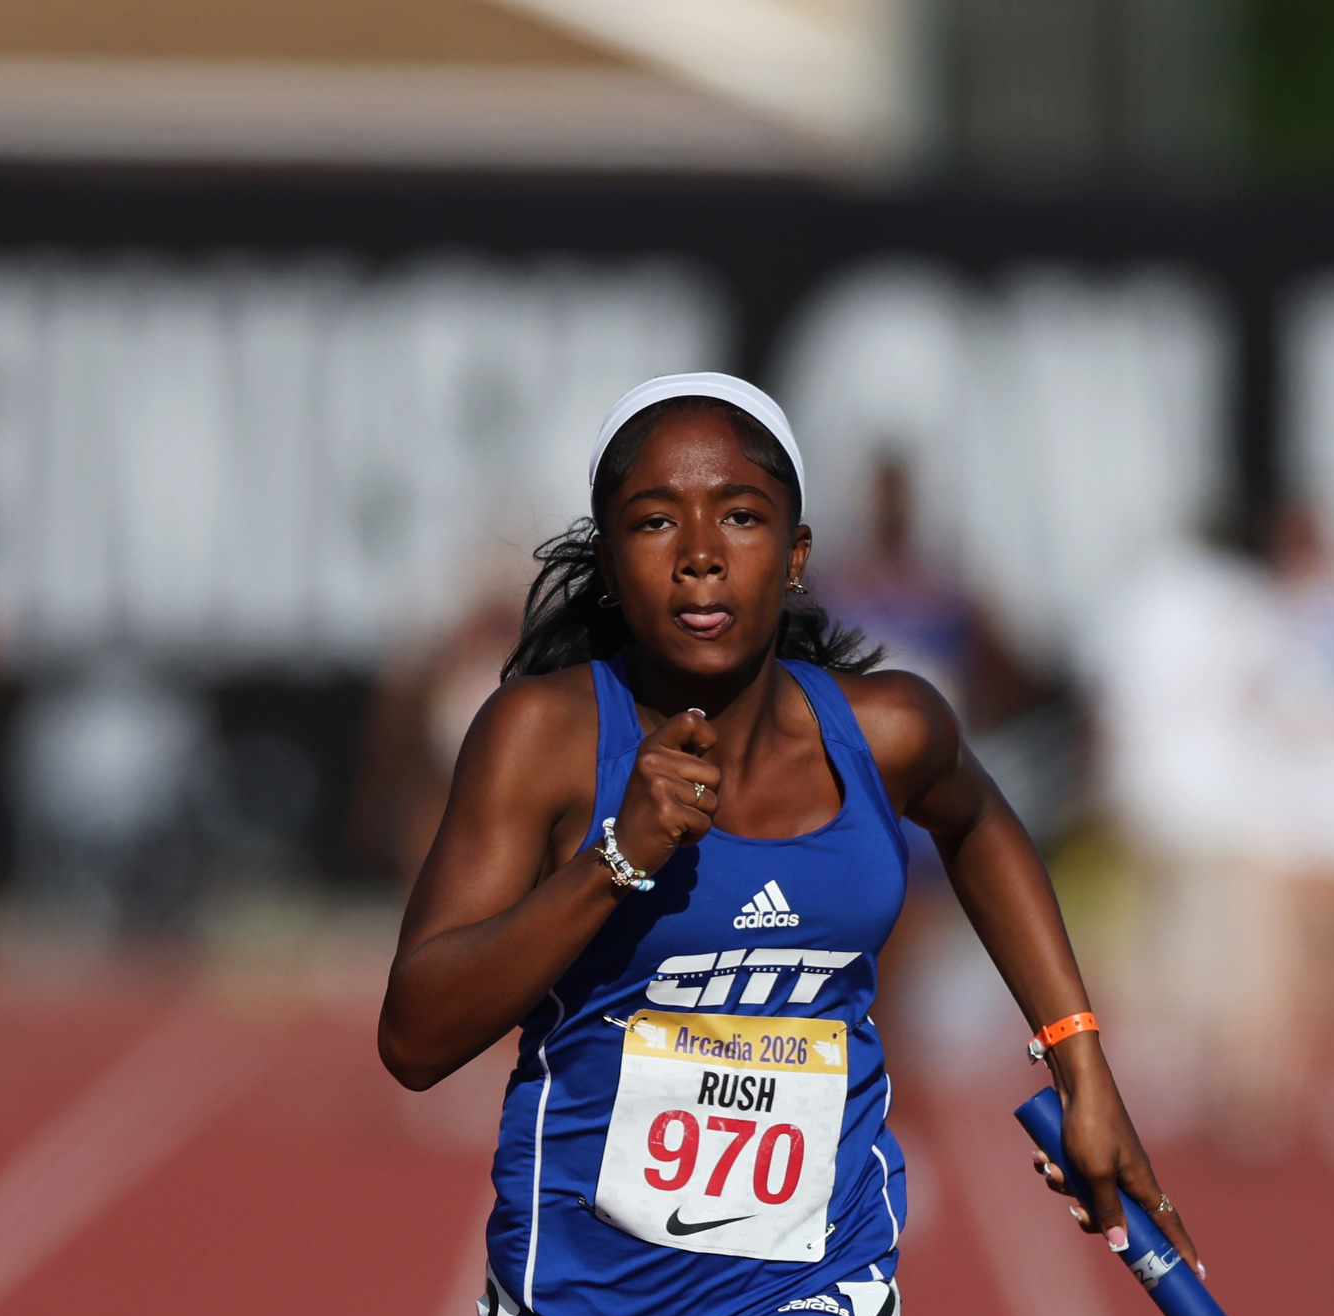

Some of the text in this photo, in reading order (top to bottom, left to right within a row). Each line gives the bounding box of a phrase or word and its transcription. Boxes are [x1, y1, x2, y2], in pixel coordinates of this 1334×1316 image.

[733, 910, 800, 930] adidas
[674, 1026, 808, 1065] Arcadia 2026
[697, 1071, 776, 1113] RUSH
[644, 1109, 805, 1205] 970
